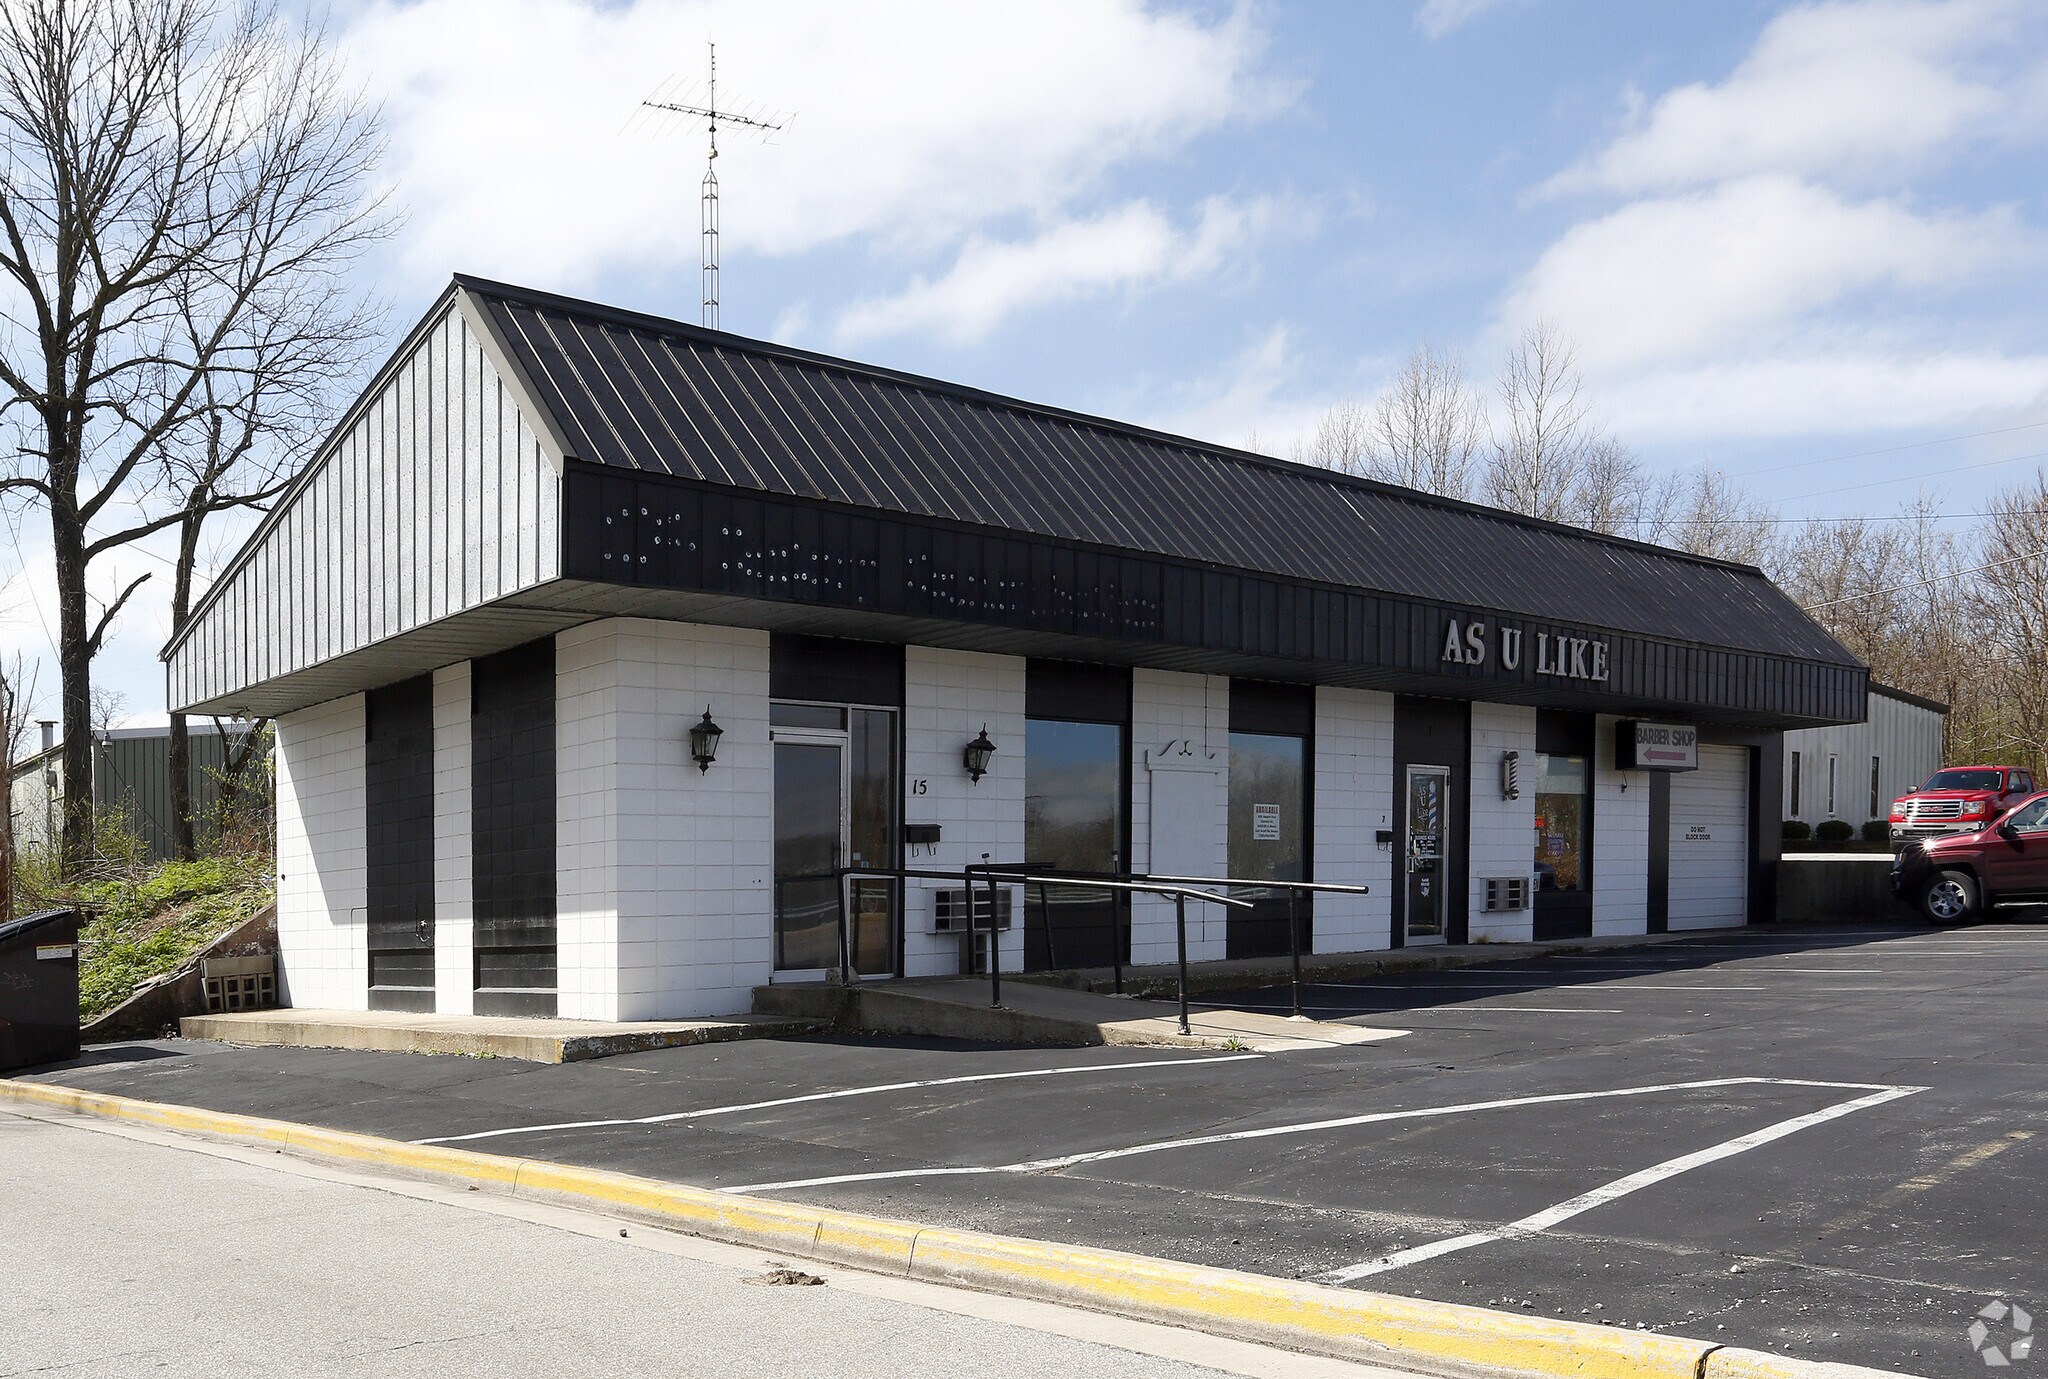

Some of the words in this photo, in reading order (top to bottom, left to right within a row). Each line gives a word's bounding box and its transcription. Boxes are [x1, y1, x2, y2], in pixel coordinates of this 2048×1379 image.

[1442, 619, 1485, 665] AS
[1501, 627, 1522, 670] U
[1536, 632, 1609, 681] LIKE
[1636, 727, 1670, 746] BARBER
[1672, 729, 1695, 747] SHOP
[913, 779, 927, 795] 15
